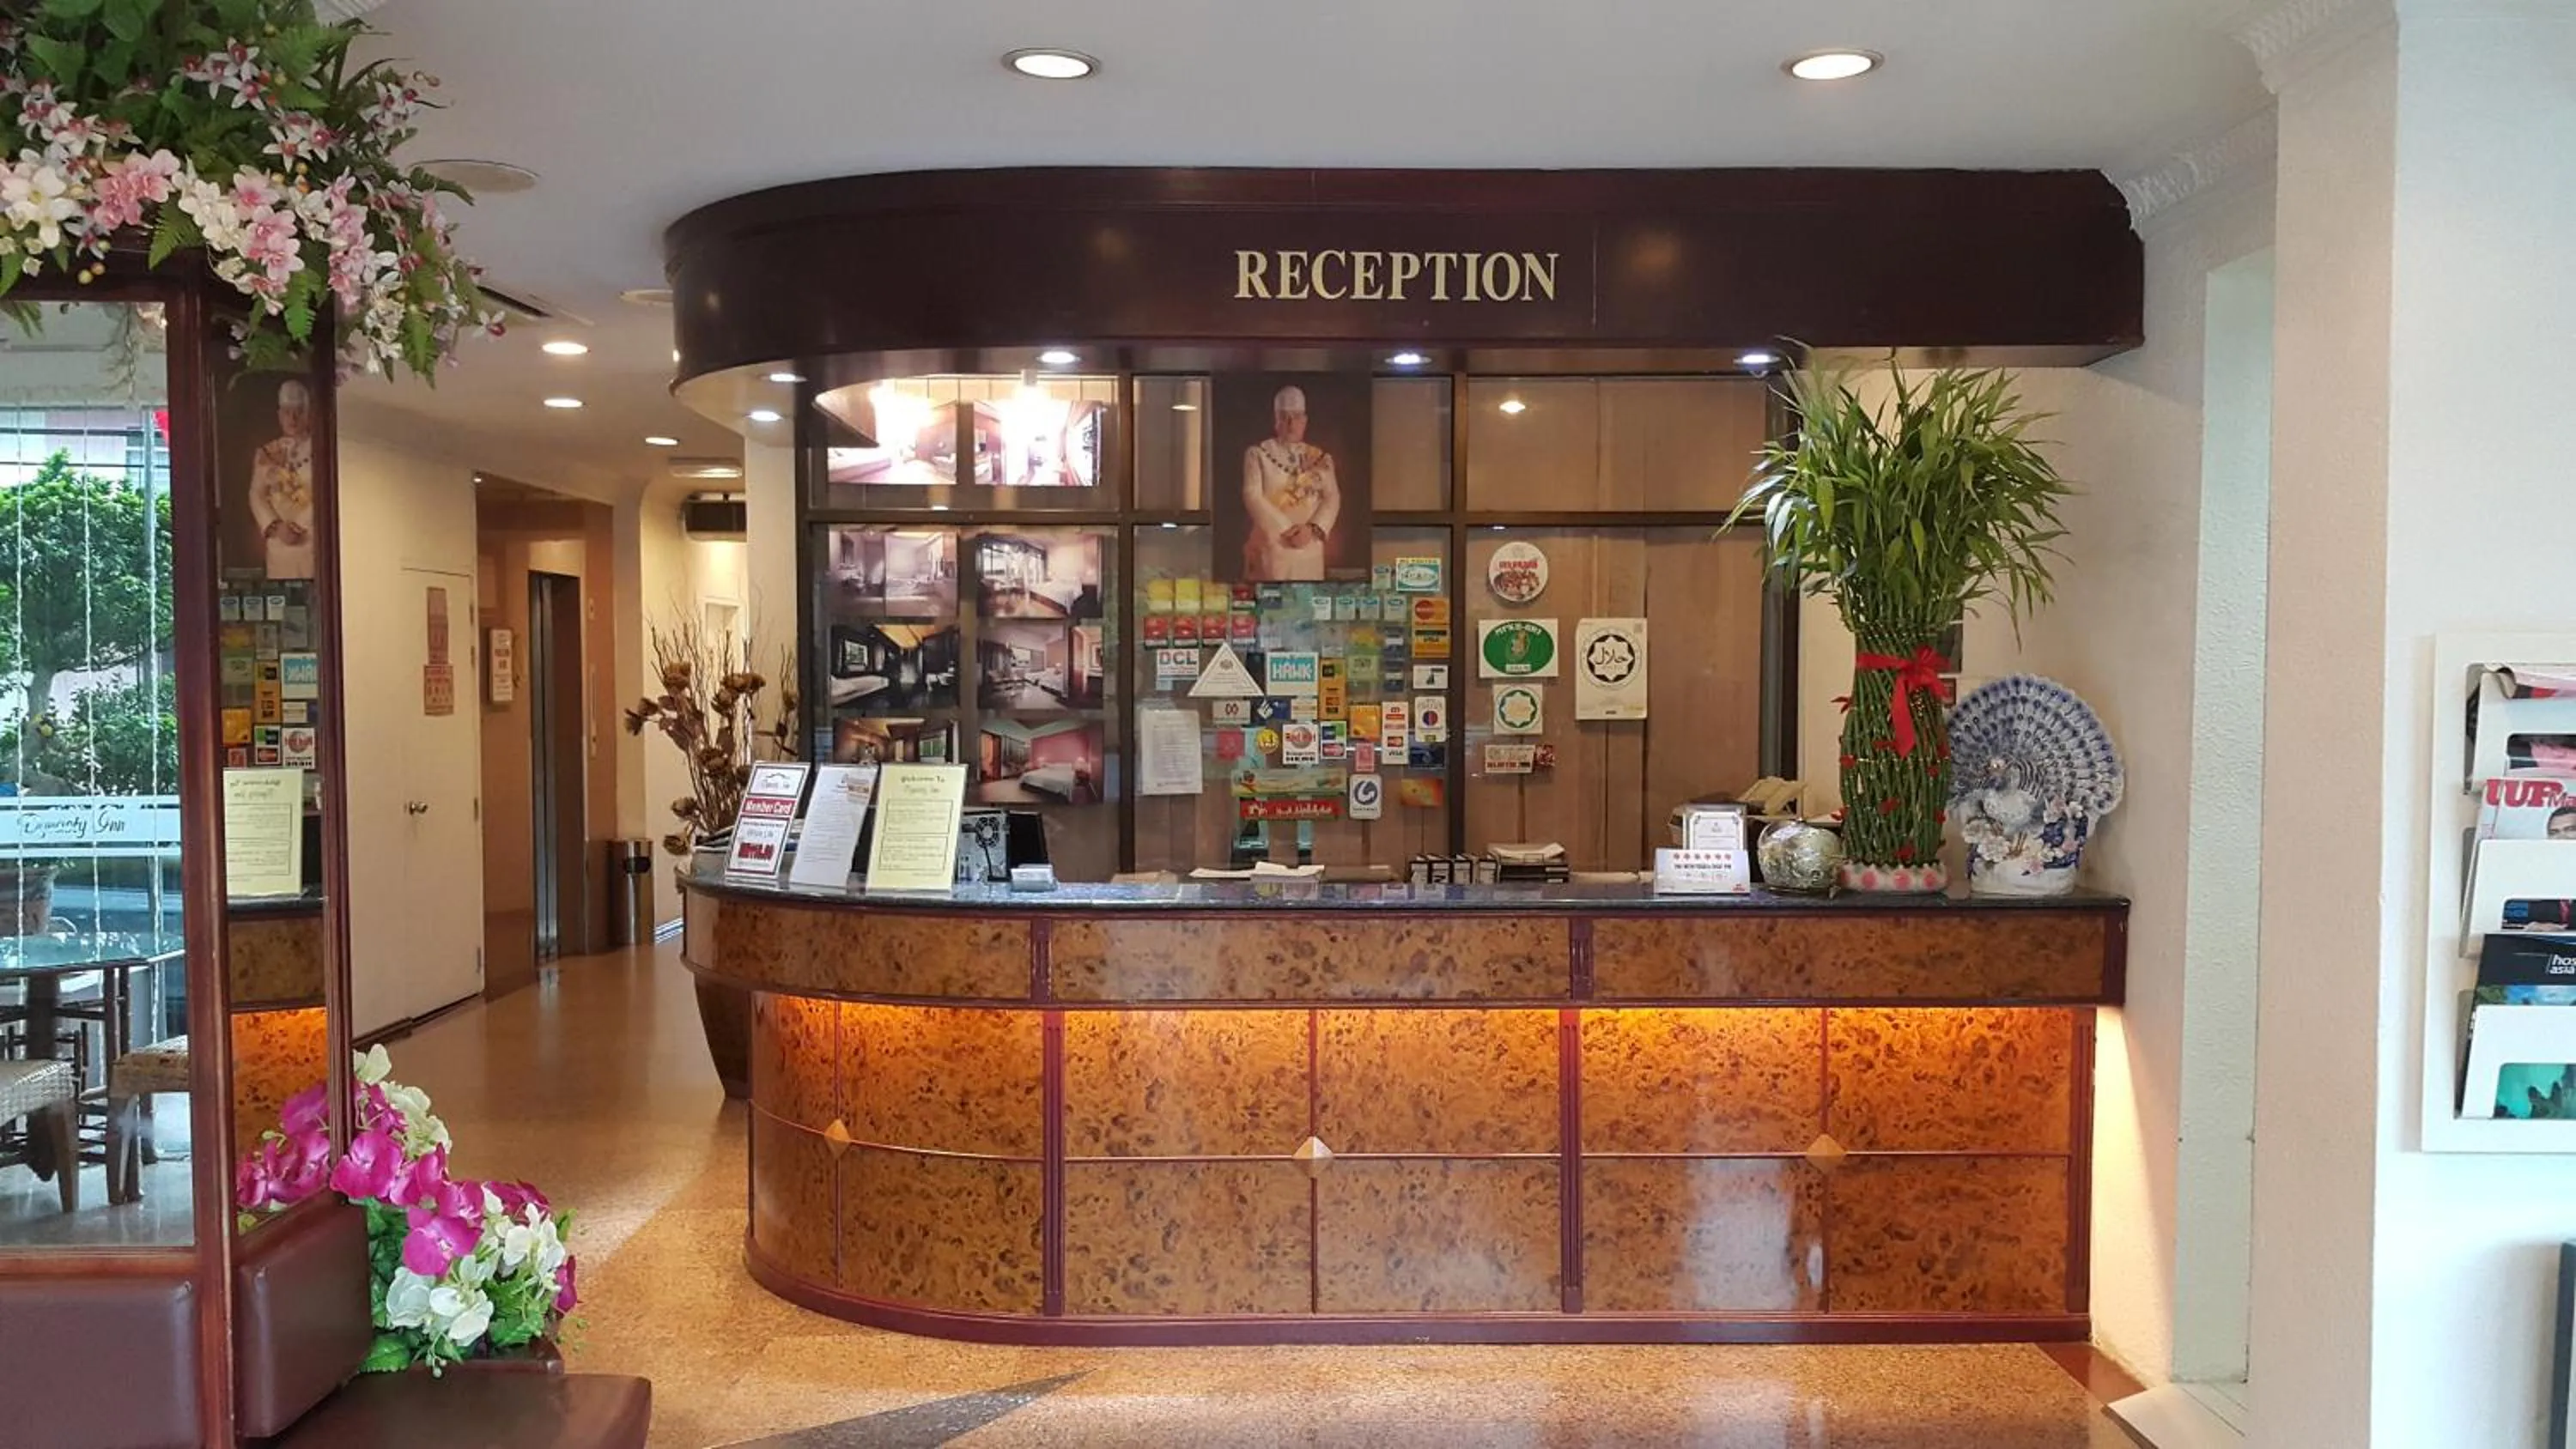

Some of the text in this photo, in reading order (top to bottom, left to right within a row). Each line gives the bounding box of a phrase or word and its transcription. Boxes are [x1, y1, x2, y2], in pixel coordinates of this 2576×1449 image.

[1234, 249, 1559, 301] RECEPTION
[1159, 649, 1197, 665] DCL
[1595, 646, 1628, 665] حلال
[1271, 662, 1314, 680] HAWK
[745, 798, 793, 815] Member Card
[2549, 966, 2575, 975] asia
